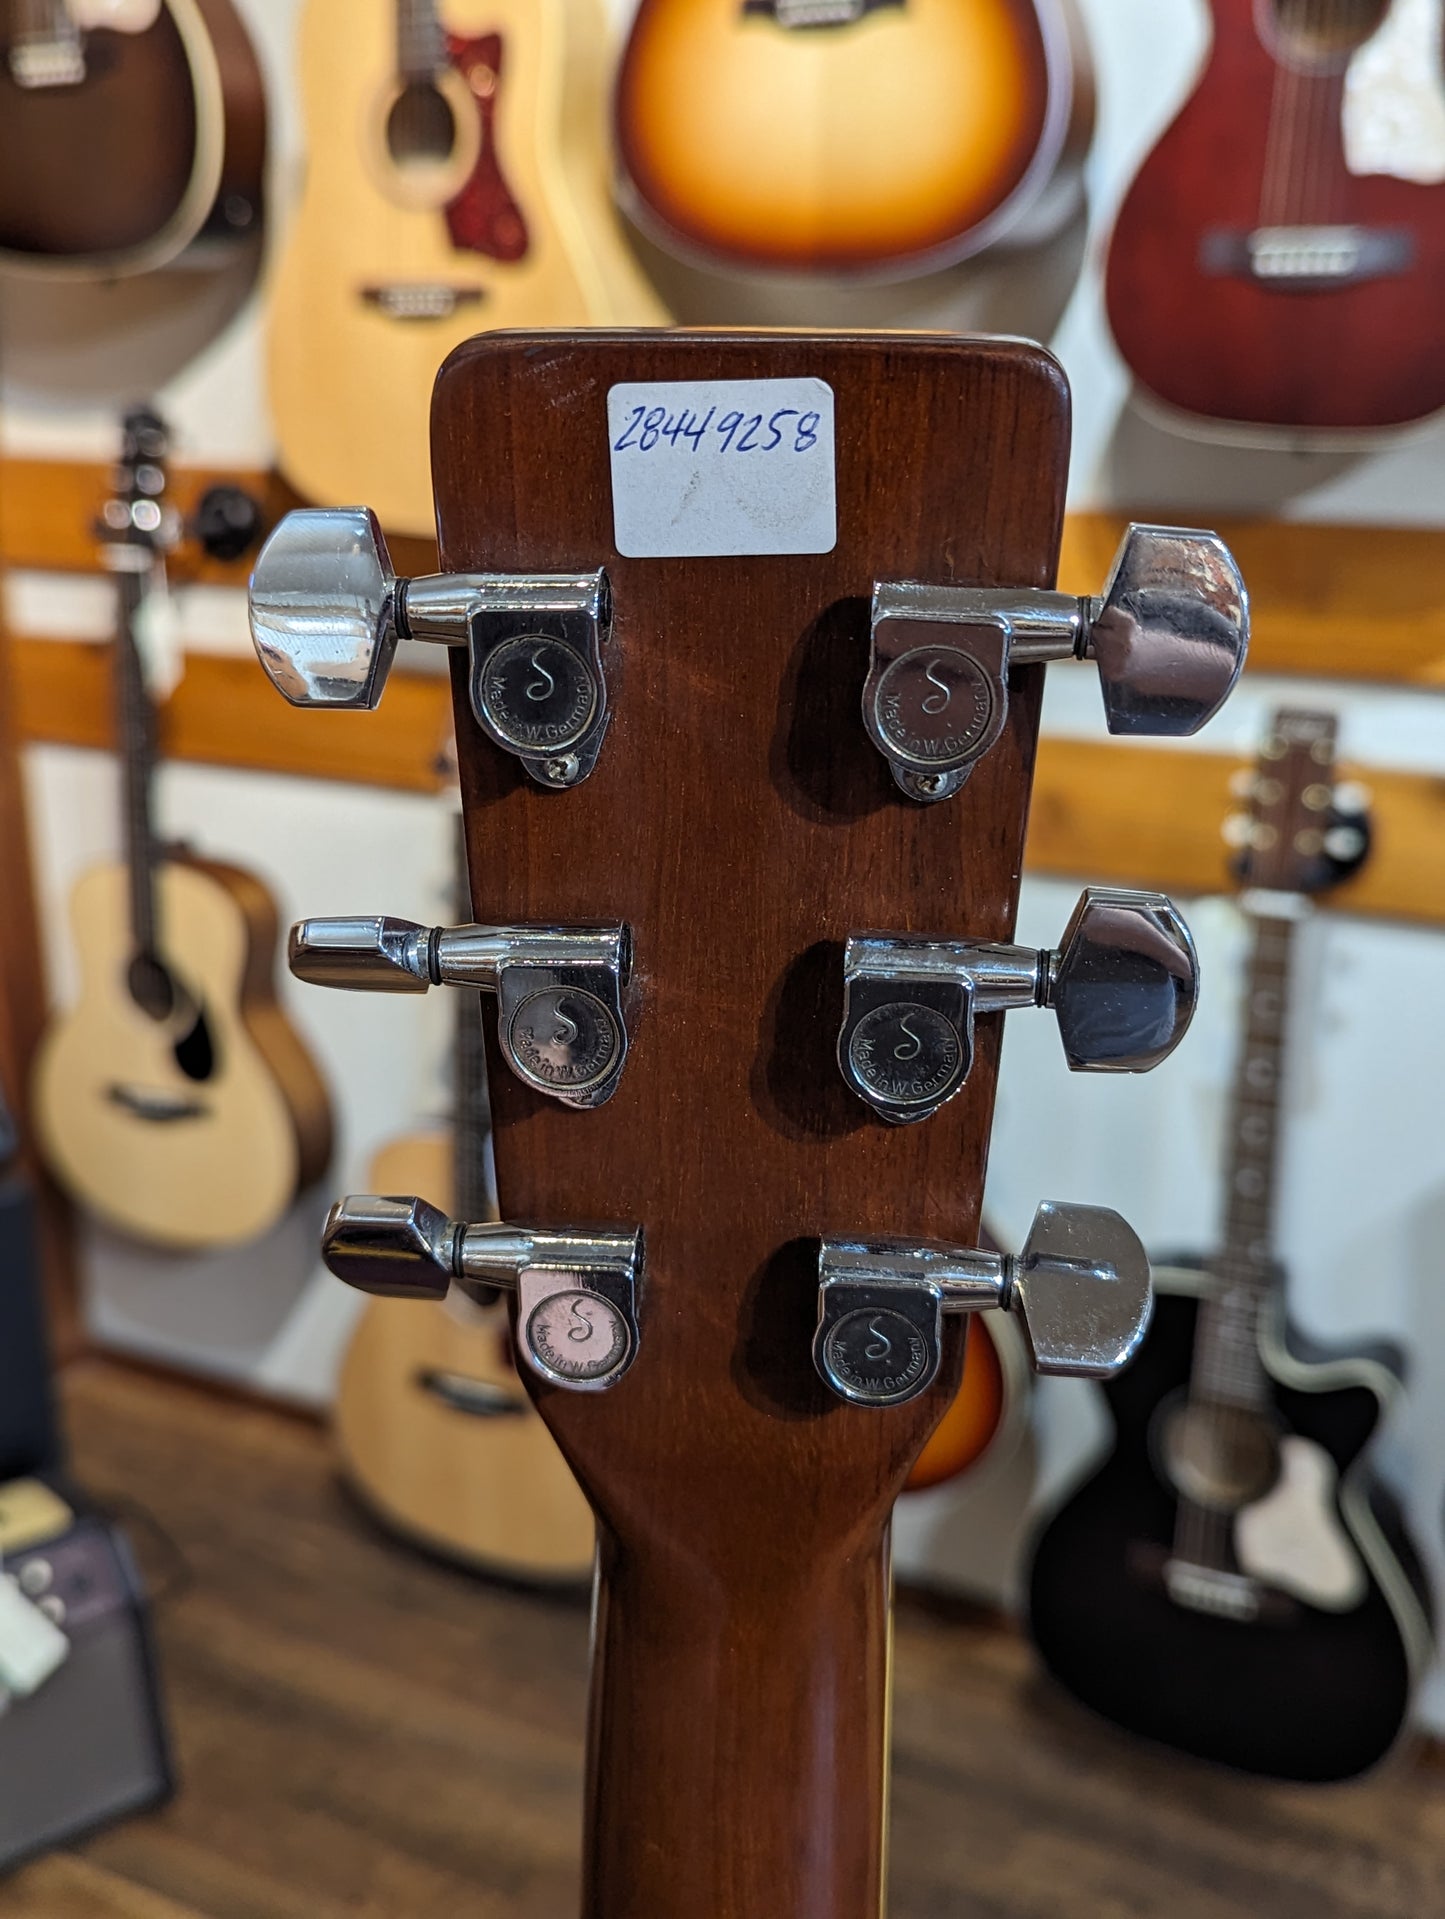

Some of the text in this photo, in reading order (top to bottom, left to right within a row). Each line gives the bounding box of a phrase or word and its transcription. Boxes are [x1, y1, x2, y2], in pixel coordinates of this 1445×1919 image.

[614, 406, 820, 453] 28449258
[859, 1038, 876, 1078] Made
[537, 1324, 555, 1359] Made
[832, 1340, 852, 1376] Made
